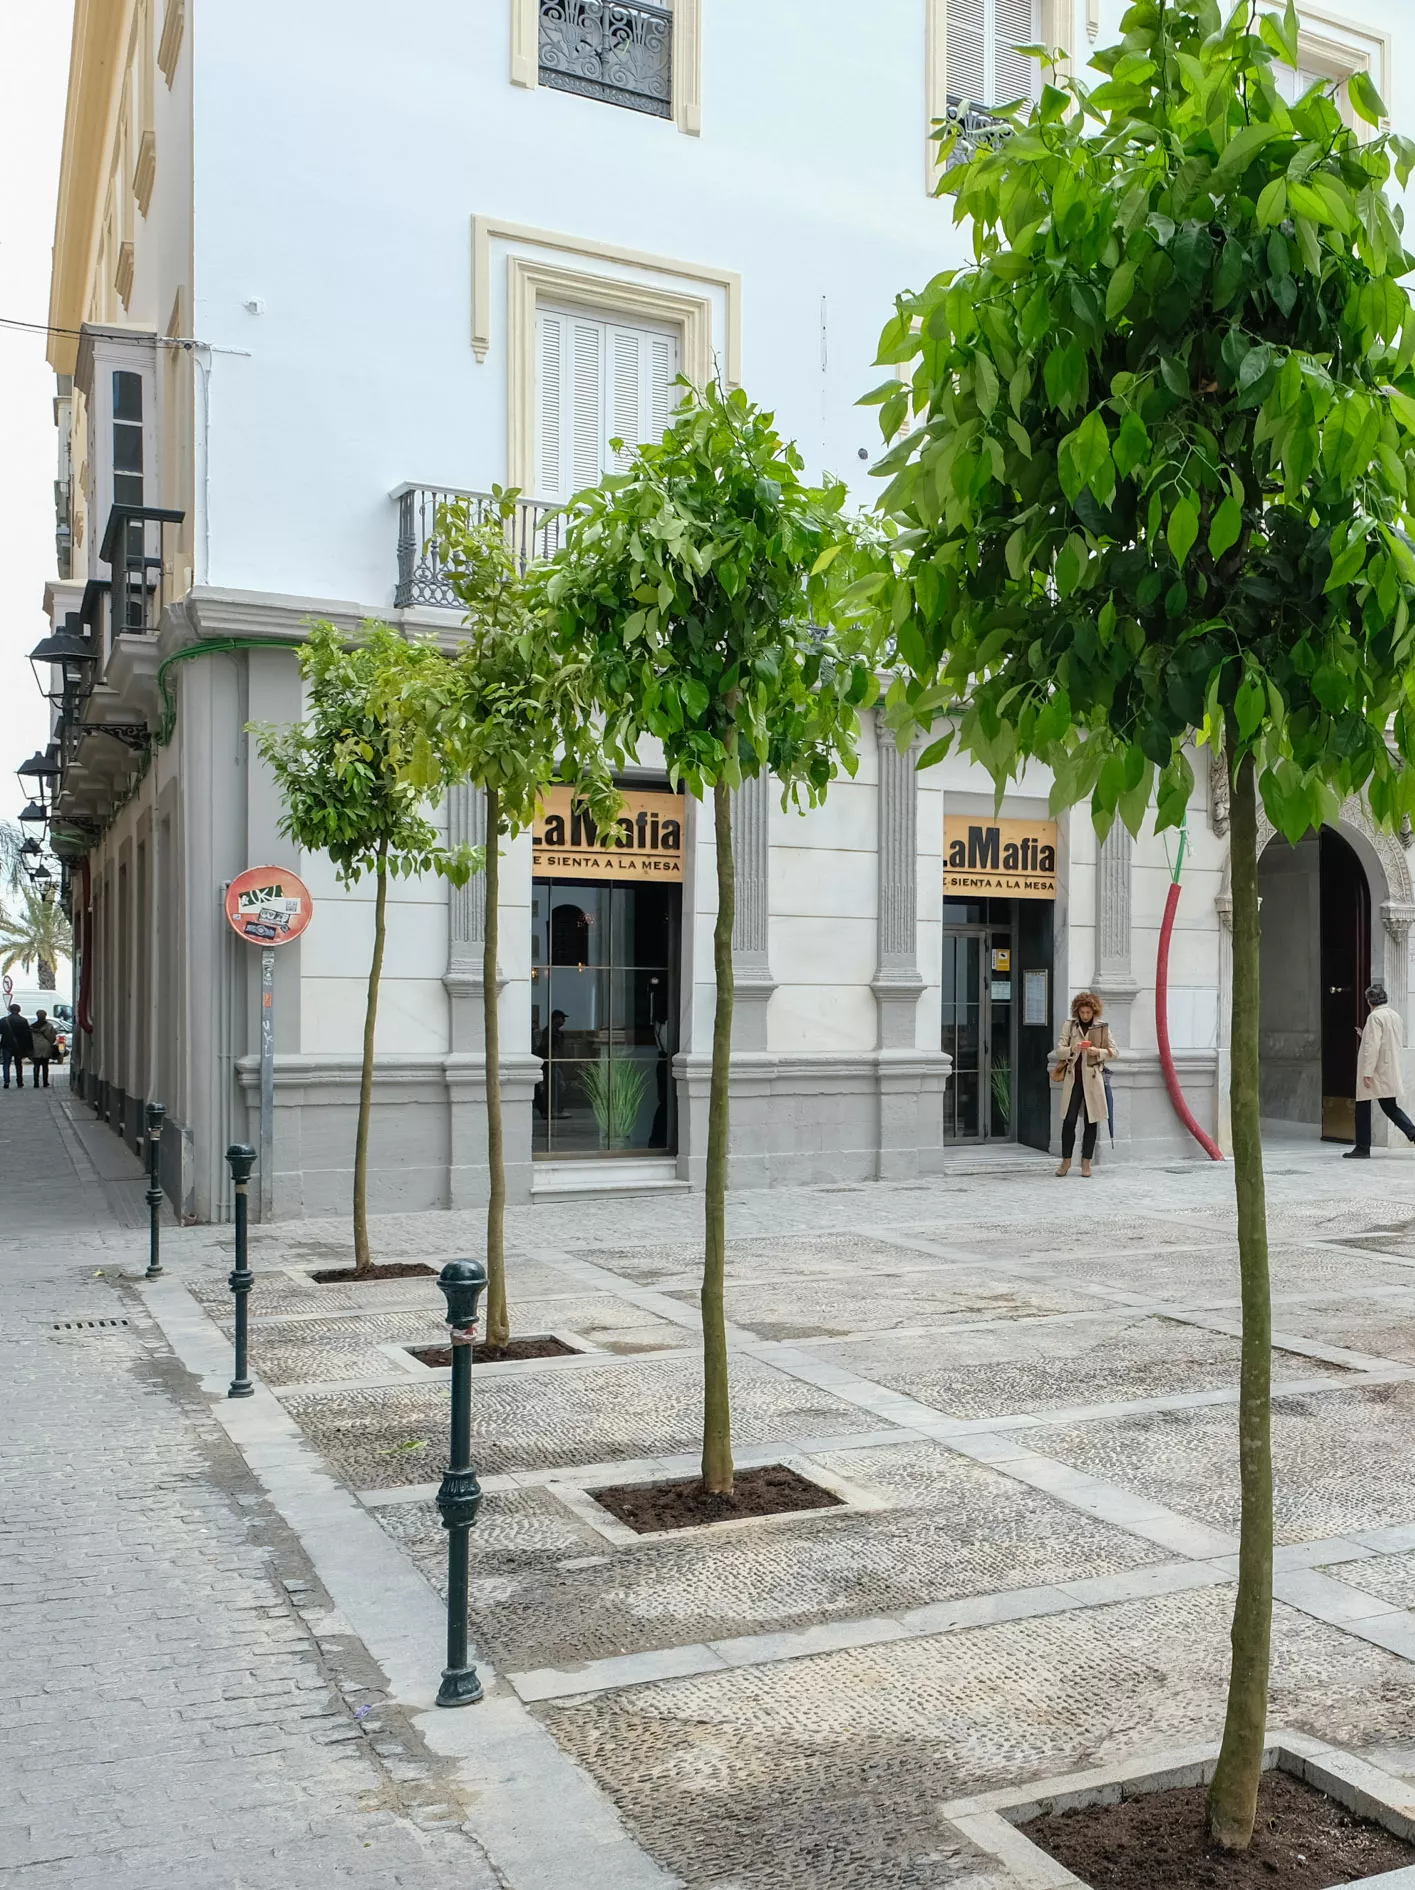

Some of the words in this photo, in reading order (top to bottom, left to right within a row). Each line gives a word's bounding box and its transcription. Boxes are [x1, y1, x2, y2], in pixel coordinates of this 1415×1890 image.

[547, 856, 600, 868] SIENTA
[605, 859, 614, 868] A
[618, 859, 637, 870] LA
[641, 861, 681, 872] MESA
[951, 877, 992, 888] SIENTA
[995, 879, 1003, 888] A
[1006, 880, 1021, 889] LA
[1024, 880, 1055, 890] MESA
